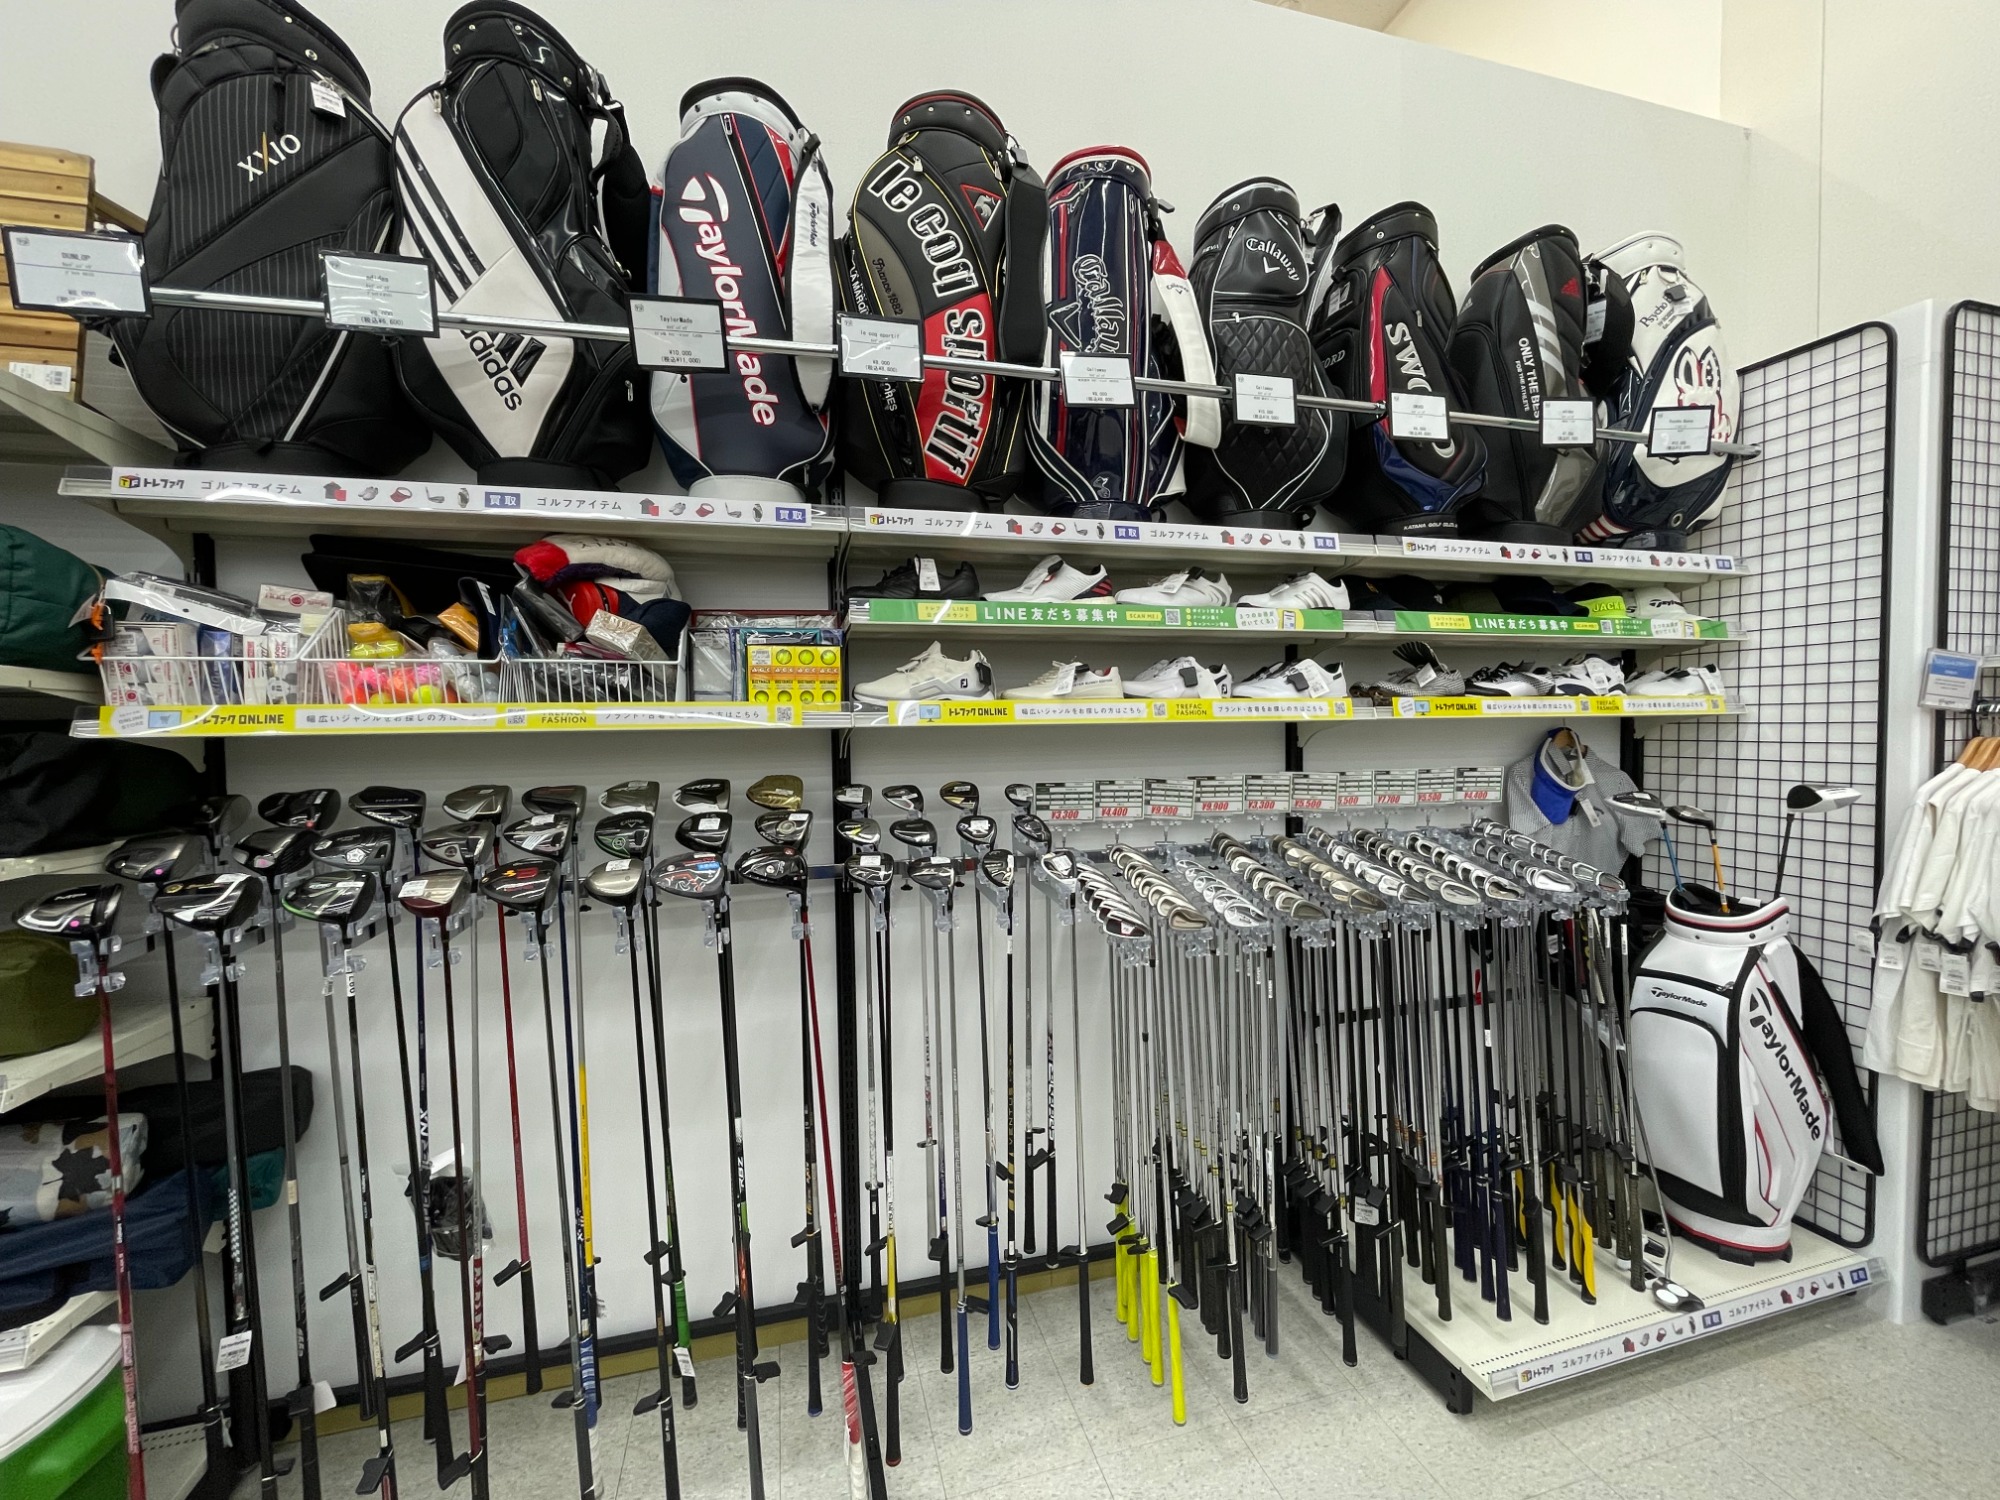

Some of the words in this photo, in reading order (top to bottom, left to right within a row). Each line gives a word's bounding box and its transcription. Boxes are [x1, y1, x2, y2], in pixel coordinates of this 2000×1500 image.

[237, 131, 301, 182] XXIO
[867, 159, 922, 213] le
[907, 202, 979, 298] coq
[1246, 238, 1300, 281] Callaway
[887, 290, 904, 316] 1882
[660, 315, 693, 324] TaylorMade
[1518, 337, 1535, 366] ONLY
[1527, 369, 1539, 394] THE
[1531, 395, 1540, 418] BES
[144, 478, 185, 490] トレファク
[489, 494, 517, 506] 買取
[537, 496, 622, 511] ゴルフアイテム
[779, 510, 803, 522] 買取
[925, 517, 992, 530] ゴルフアテム
[1117, 527, 1139, 538] 買取
[1149, 528, 1209, 541] ゴルフアイテム
[1316, 538, 1336, 549] 買取
[978, 708, 1008, 716] ONLINE
[1456, 703, 1477, 711] ONLINE
[238, 714, 284, 725] ONLINE
[541, 716, 587, 724] FASHION
[1102, 807, 1128, 817] ¥4,400
[1151, 805, 1178, 816] ¥9,900
[1202, 801, 1229, 811] ¥9,900
[1052, 810, 1079, 820] ¥3,300
[1651, 986, 1708, 1008] TaylorMade
[1750, 986, 1821, 1141] TaylorMade
[1562, 1347, 1613, 1370] ゴルフアイテム
